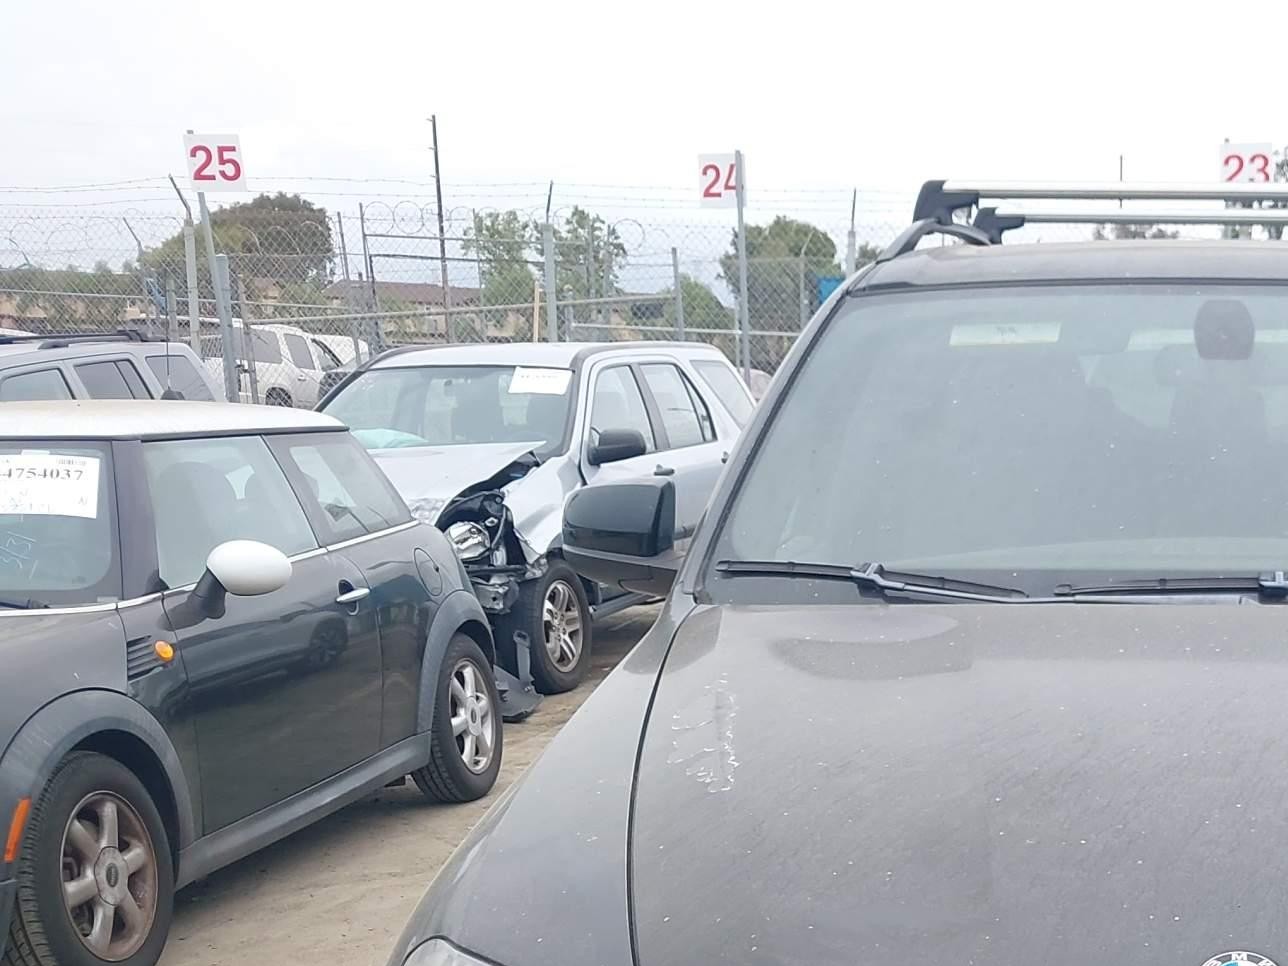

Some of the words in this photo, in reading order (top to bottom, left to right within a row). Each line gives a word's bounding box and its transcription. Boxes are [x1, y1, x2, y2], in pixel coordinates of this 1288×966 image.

[189, 145, 241, 181] 25
[1223, 154, 1270, 182] 23
[702, 164, 737, 198] 24
[0, 467, 84, 480] 4754037
